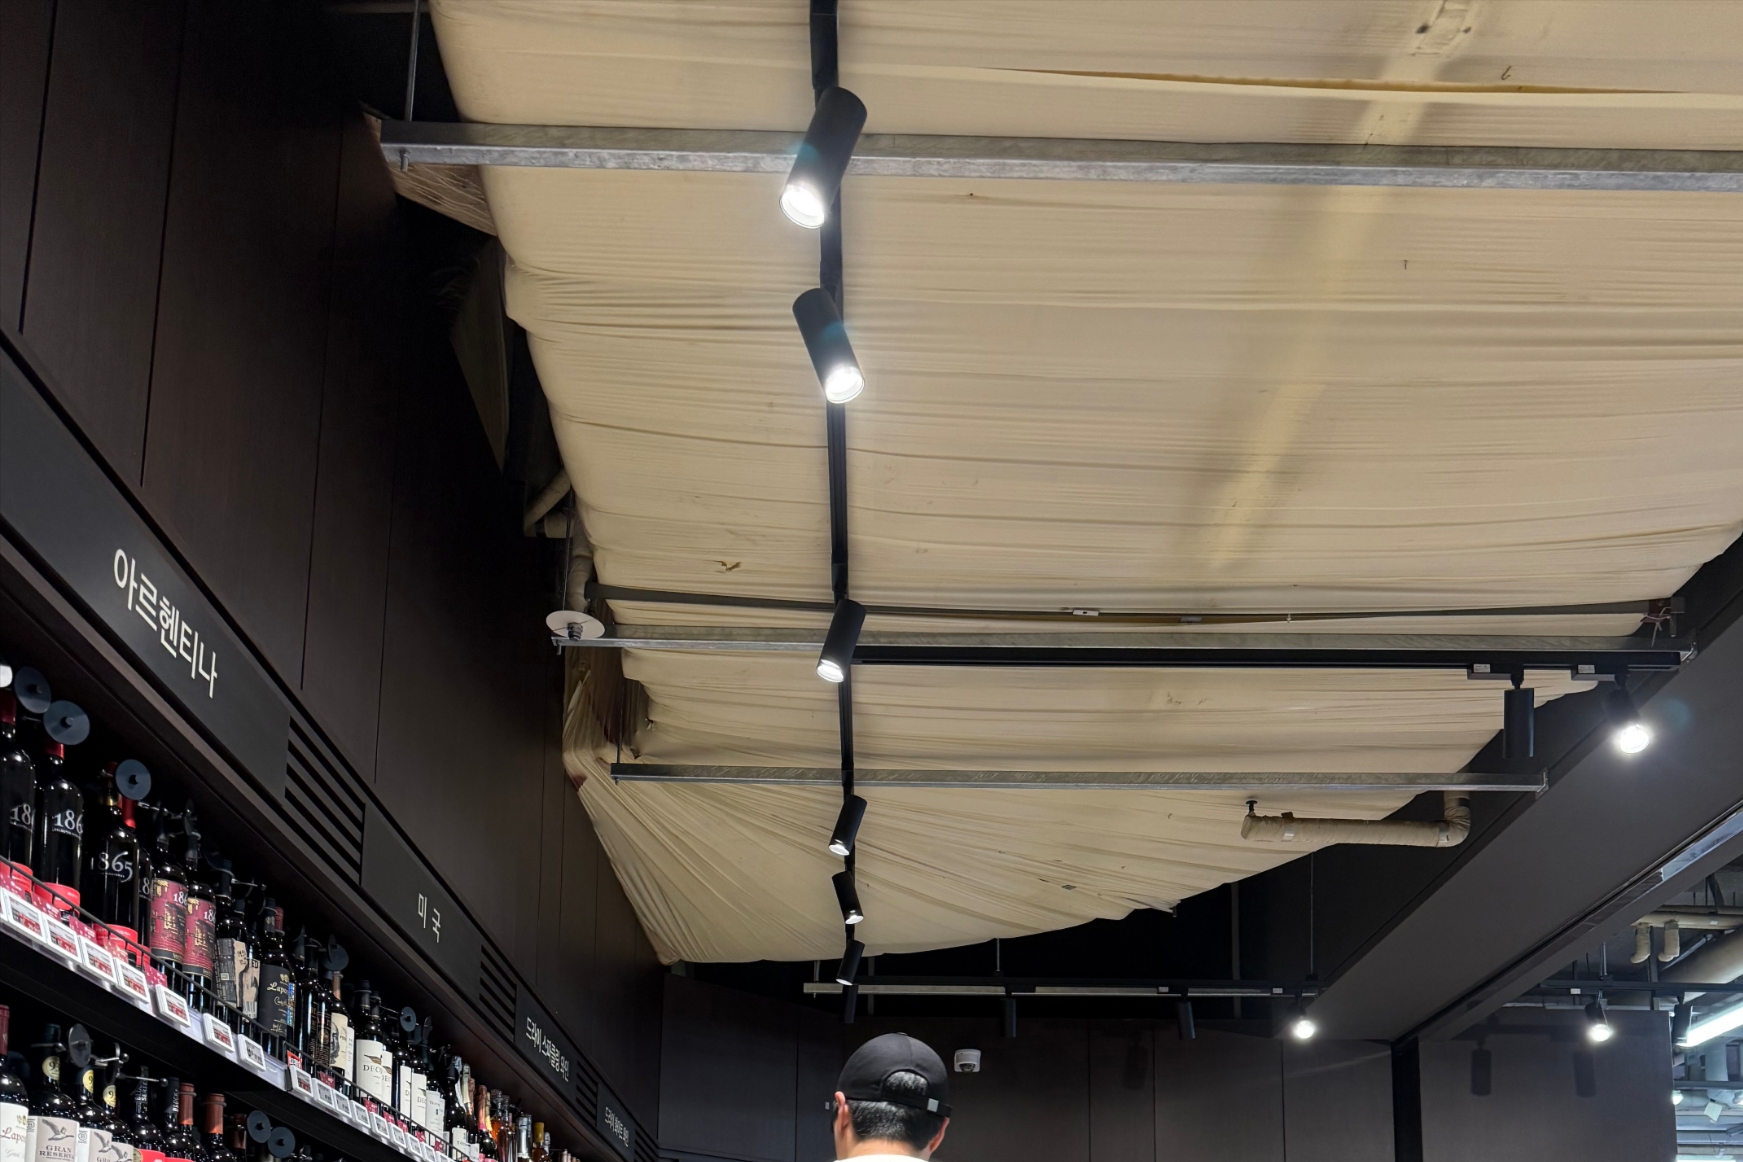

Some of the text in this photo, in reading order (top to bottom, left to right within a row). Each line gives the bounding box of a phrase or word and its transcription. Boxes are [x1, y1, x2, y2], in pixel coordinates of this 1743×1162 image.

[114, 549, 218, 699] 아르헨티나
[418, 893, 441, 943] 미국
[526, 1017, 542, 1053] 드라이
[542, 1035, 560, 1072] 스파클링
